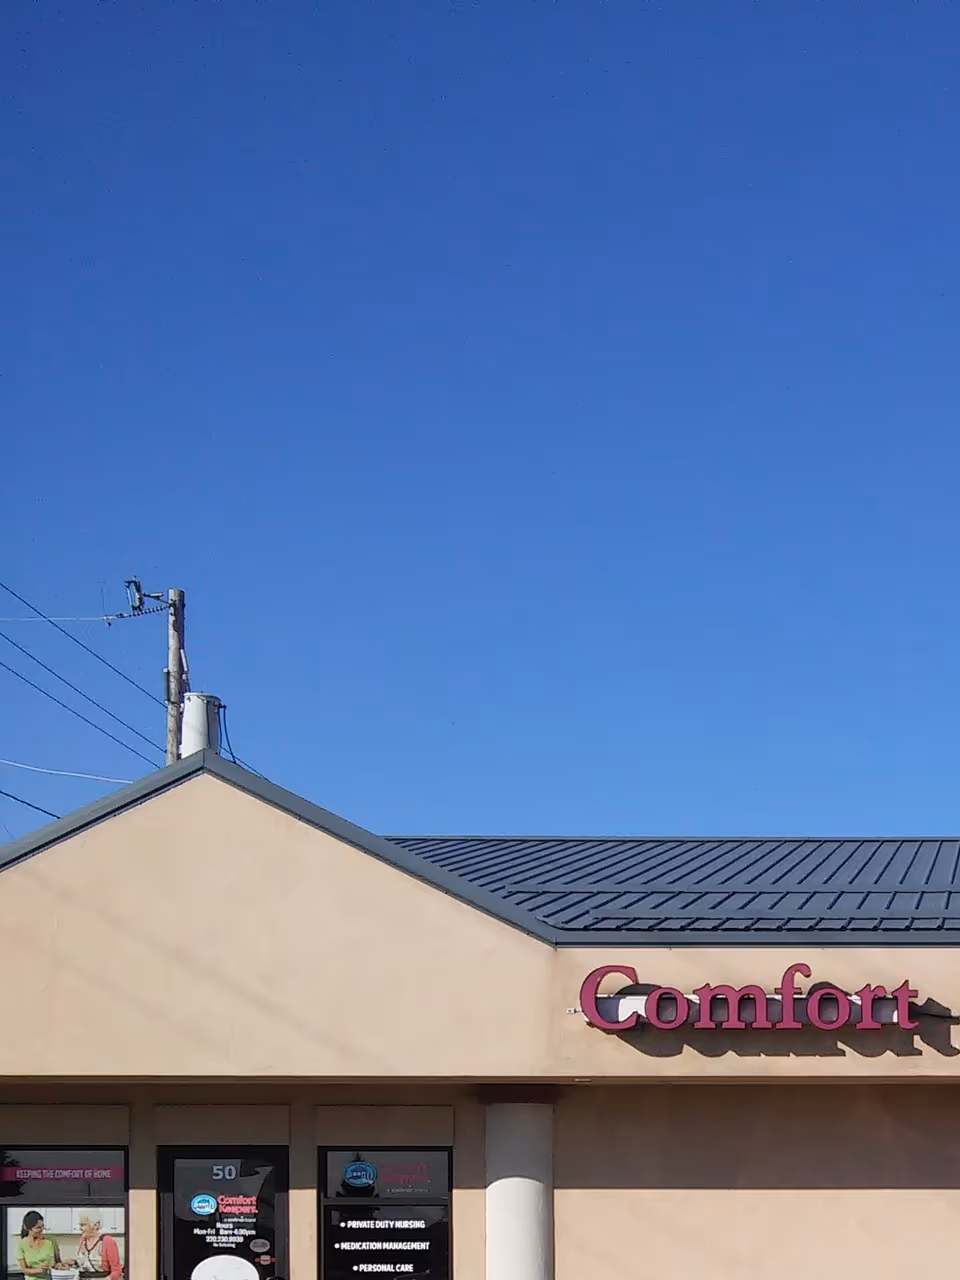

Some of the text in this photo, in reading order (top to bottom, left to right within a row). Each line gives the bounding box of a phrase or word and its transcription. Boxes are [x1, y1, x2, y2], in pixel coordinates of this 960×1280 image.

[579, 962, 919, 1030] Comfort
[16, 1169, 111, 1179] KEEPING THE COMFORT OF HOME
[212, 1165, 237, 1180] 50
[217, 1195, 257, 1205] Comfort
[347, 1220, 426, 1229] PRIVATE DUTY NURSING
[340, 1241, 430, 1250] MEDICATION MANAGEMENT
[359, 1263, 415, 1272] PERSONAL CARE
